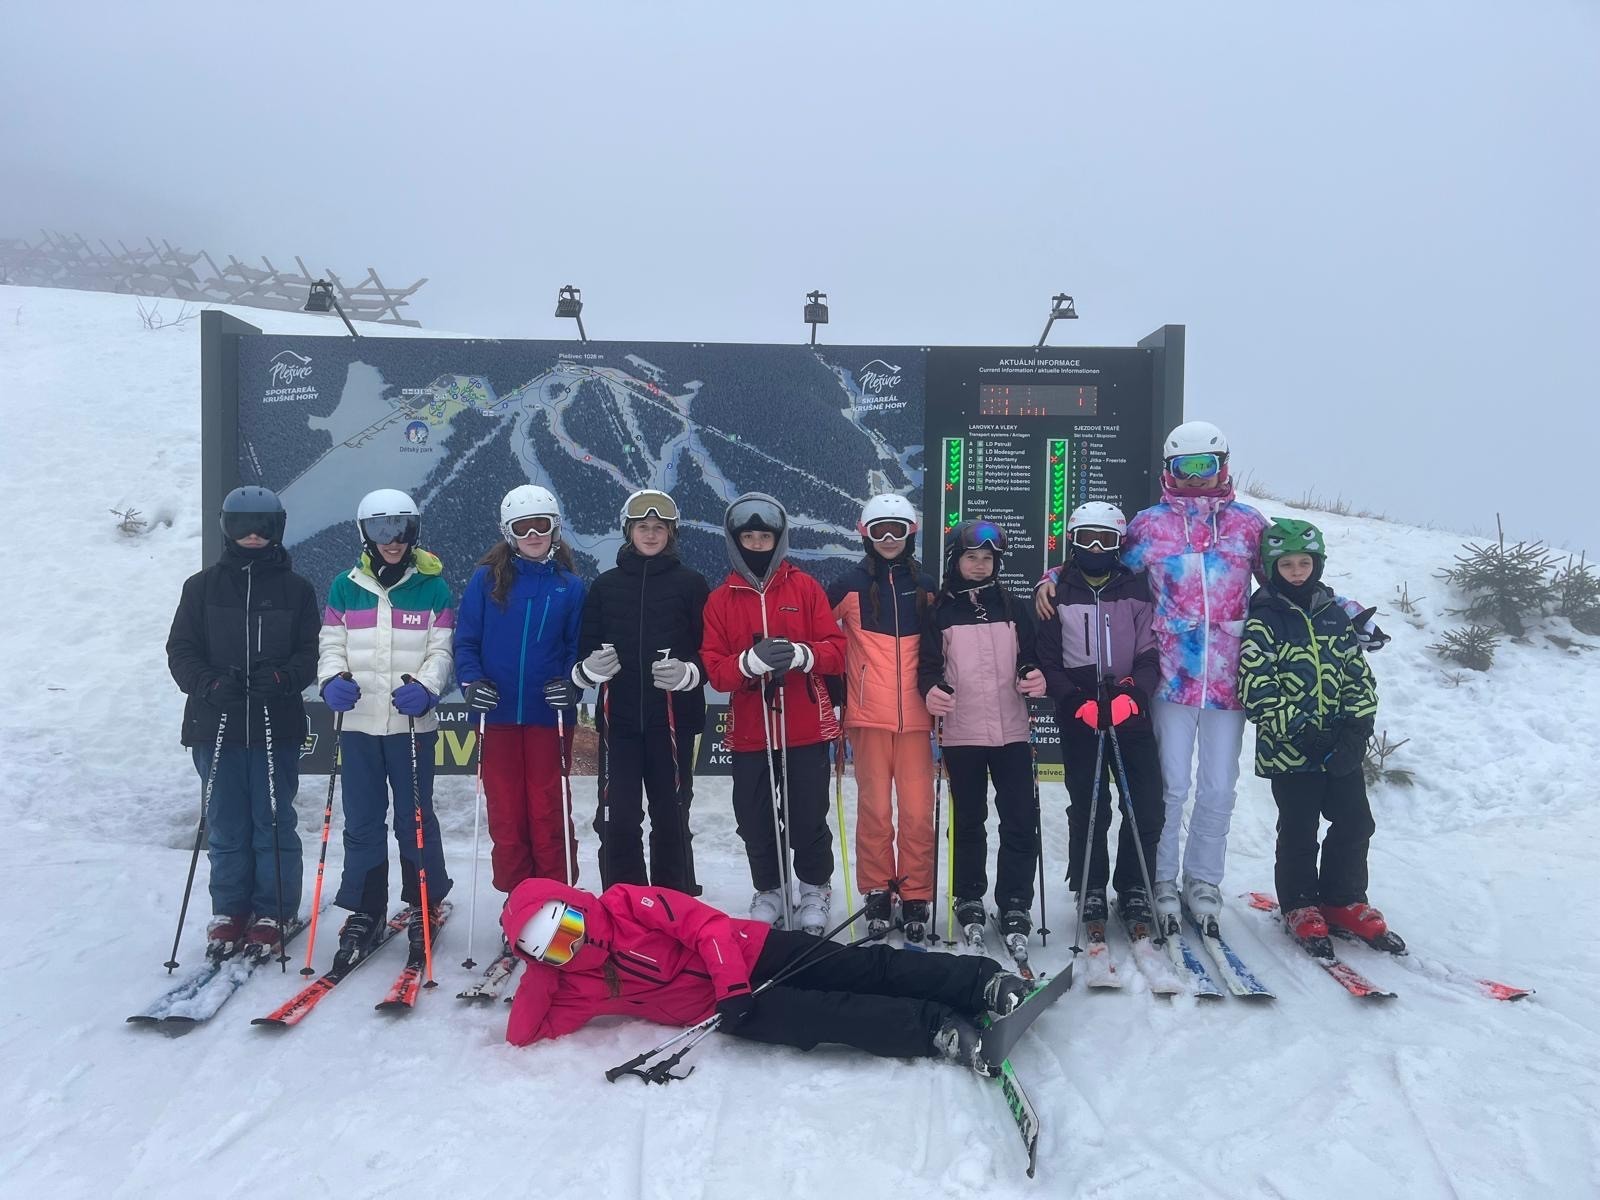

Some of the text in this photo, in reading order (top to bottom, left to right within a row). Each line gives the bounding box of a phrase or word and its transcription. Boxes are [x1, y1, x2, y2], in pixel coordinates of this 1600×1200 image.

[999, 358, 1036, 366] AKTUÁLNÍ
[269, 361, 313, 387] Plešivec
[859, 370, 901, 396] Plešivec
[265, 386, 316, 396] SPORTAREÁL
[263, 393, 319, 403] KRUŠNÉ HORY
[402, 614, 421, 625] HH
[709, 755, 717, 764] A
